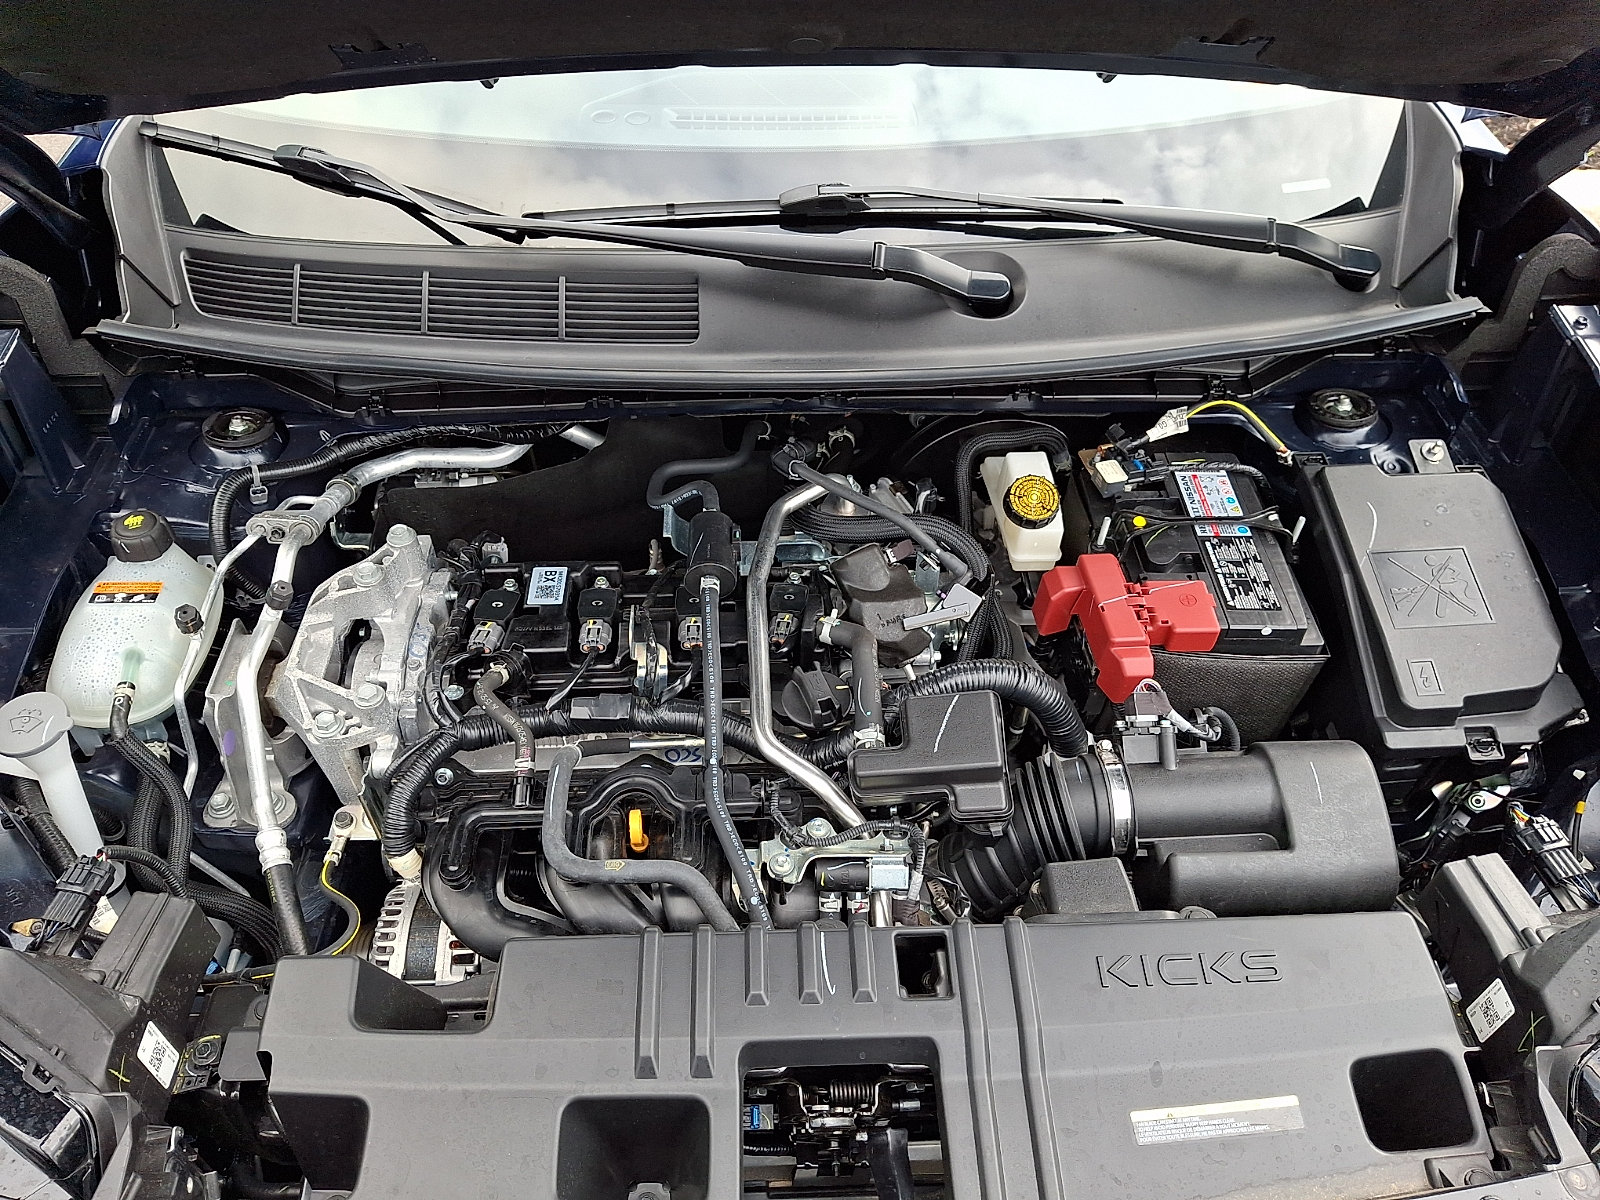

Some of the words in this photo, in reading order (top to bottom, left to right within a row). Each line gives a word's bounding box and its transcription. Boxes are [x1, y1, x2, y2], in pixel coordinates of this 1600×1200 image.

[1180, 475, 1197, 504] NISSAN
[543, 571, 558, 583] BX
[1096, 950, 1283, 988] KICKS
